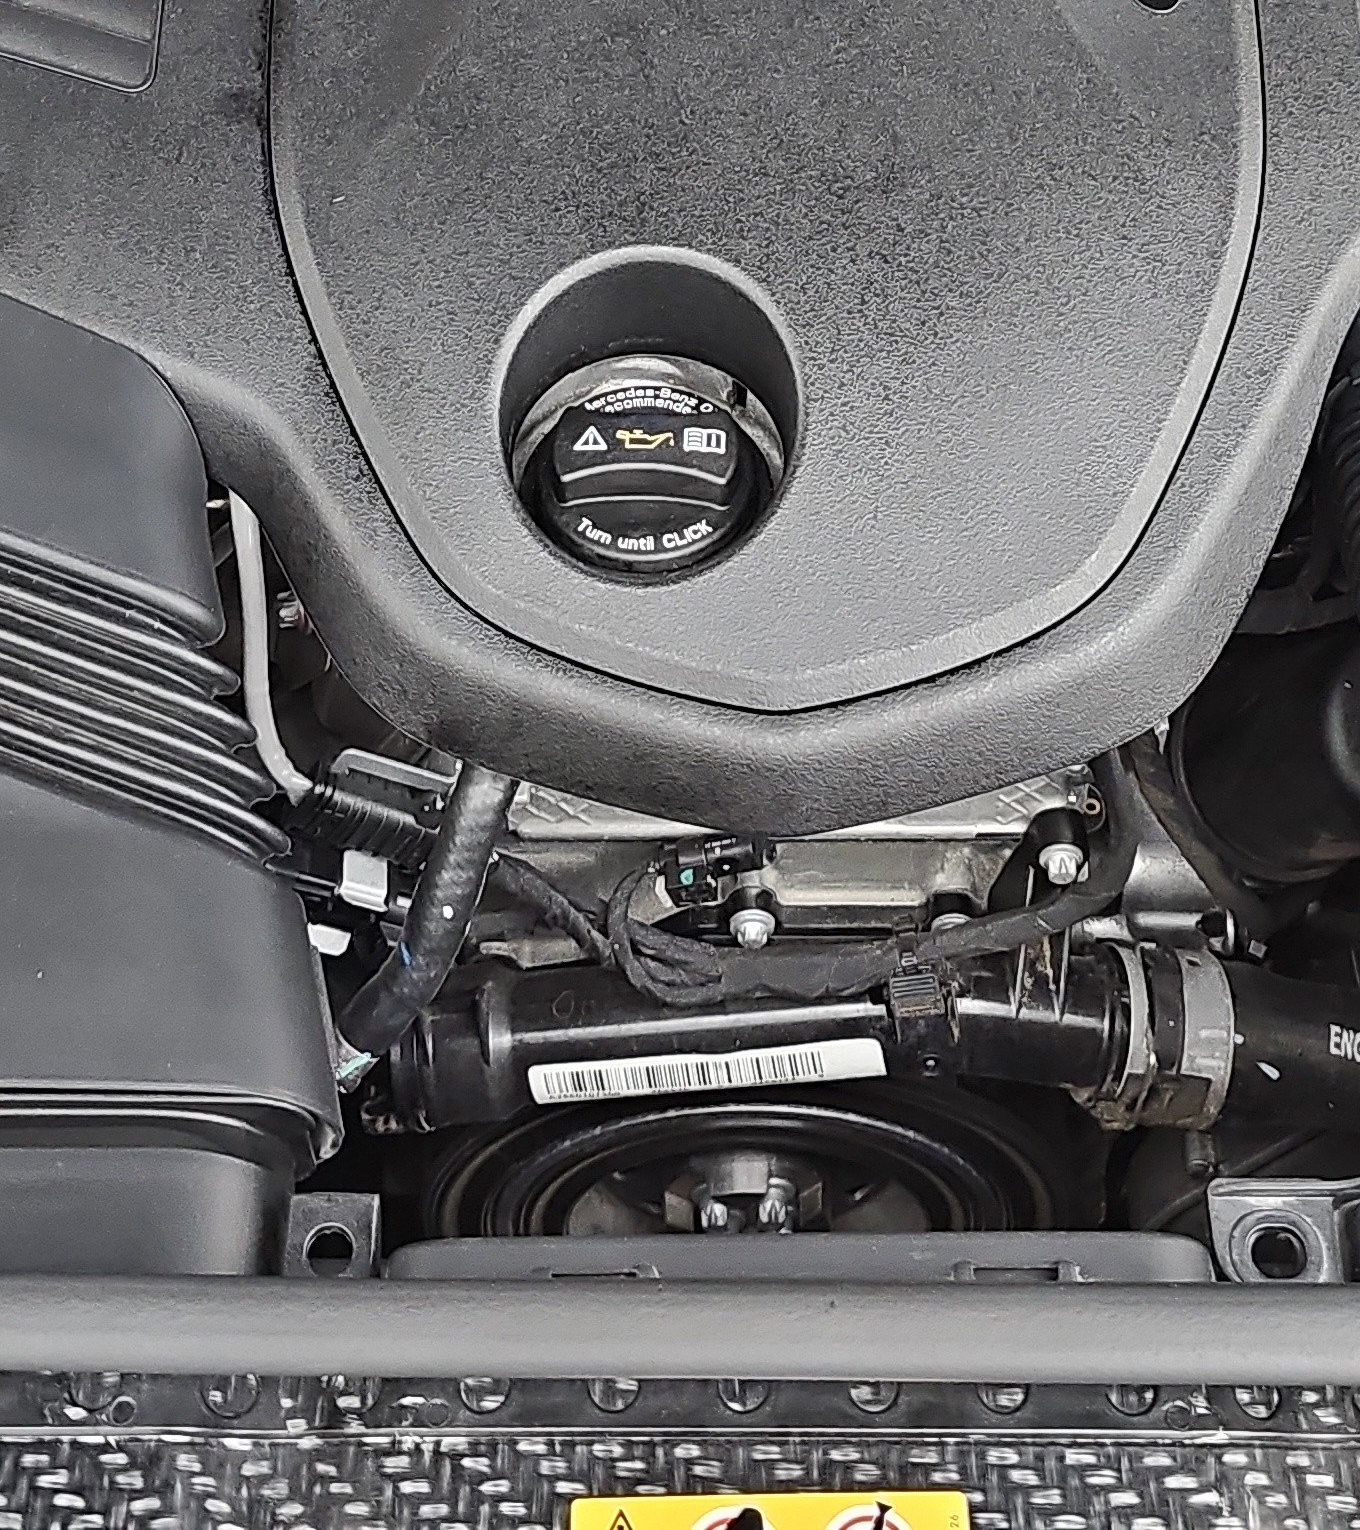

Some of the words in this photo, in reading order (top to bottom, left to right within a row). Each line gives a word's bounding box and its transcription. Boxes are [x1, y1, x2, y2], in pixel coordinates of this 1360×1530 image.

[600, 397, 698, 414] ecommende
[577, 517, 613, 545] Turn
[617, 535, 655, 551] until
[662, 518, 714, 549] CLICK
